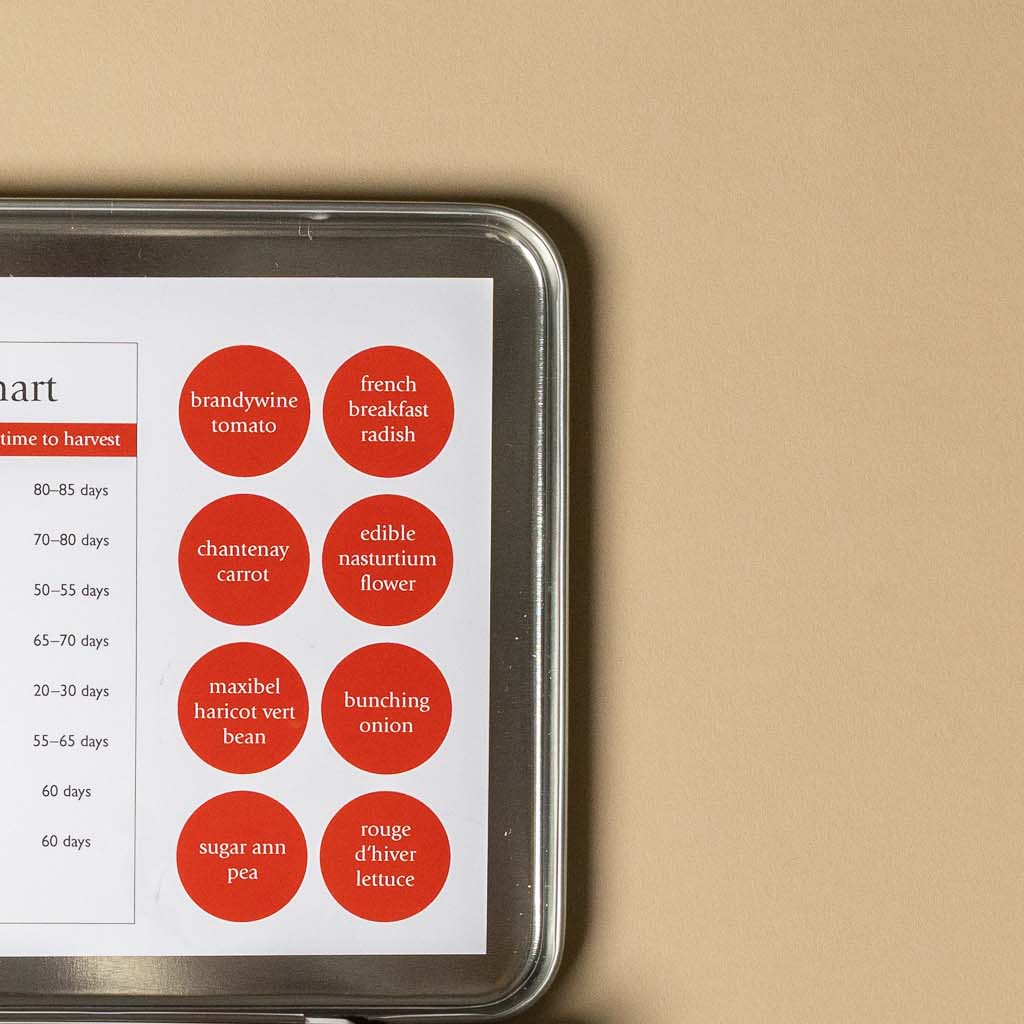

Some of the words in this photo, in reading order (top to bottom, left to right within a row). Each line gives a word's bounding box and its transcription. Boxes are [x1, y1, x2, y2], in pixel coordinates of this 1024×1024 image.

[360, 374, 417, 393] french
[190, 390, 299, 413] brandywine
[348, 399, 429, 418] breakfast
[211, 419, 277, 434] tomato
[361, 425, 416, 443] radish
[0, 430, 38, 446] time
[41, 433, 59, 447] to
[63, 430, 121, 447] harvest
[80, 483, 109, 500] days
[81, 533, 110, 550] days
[360, 524, 416, 542] edible
[197, 539, 290, 562] chantenay
[338, 549, 437, 567] nasturtium
[216, 568, 270, 582] carrot
[360, 573, 417, 592] flower
[81, 583, 110, 601] days
[80, 634, 109, 651] days
[81, 684, 110, 701] days
[209, 677, 280, 695] maxibel
[194, 701, 257, 720] haricot
[262, 706, 296, 720] vert
[344, 690, 431, 713] bunching
[359, 716, 414, 733] onion
[80, 734, 109, 751] days
[223, 727, 266, 745] bean
[41, 784, 59, 798] 60
[63, 784, 92, 801] days
[361, 824, 412, 842] rouge
[41, 834, 58, 848] 60
[62, 834, 92, 851] days
[199, 842, 248, 859] sugar
[251, 842, 286, 855] ann
[227, 867, 258, 884] pea
[356, 869, 415, 887] lettuce
